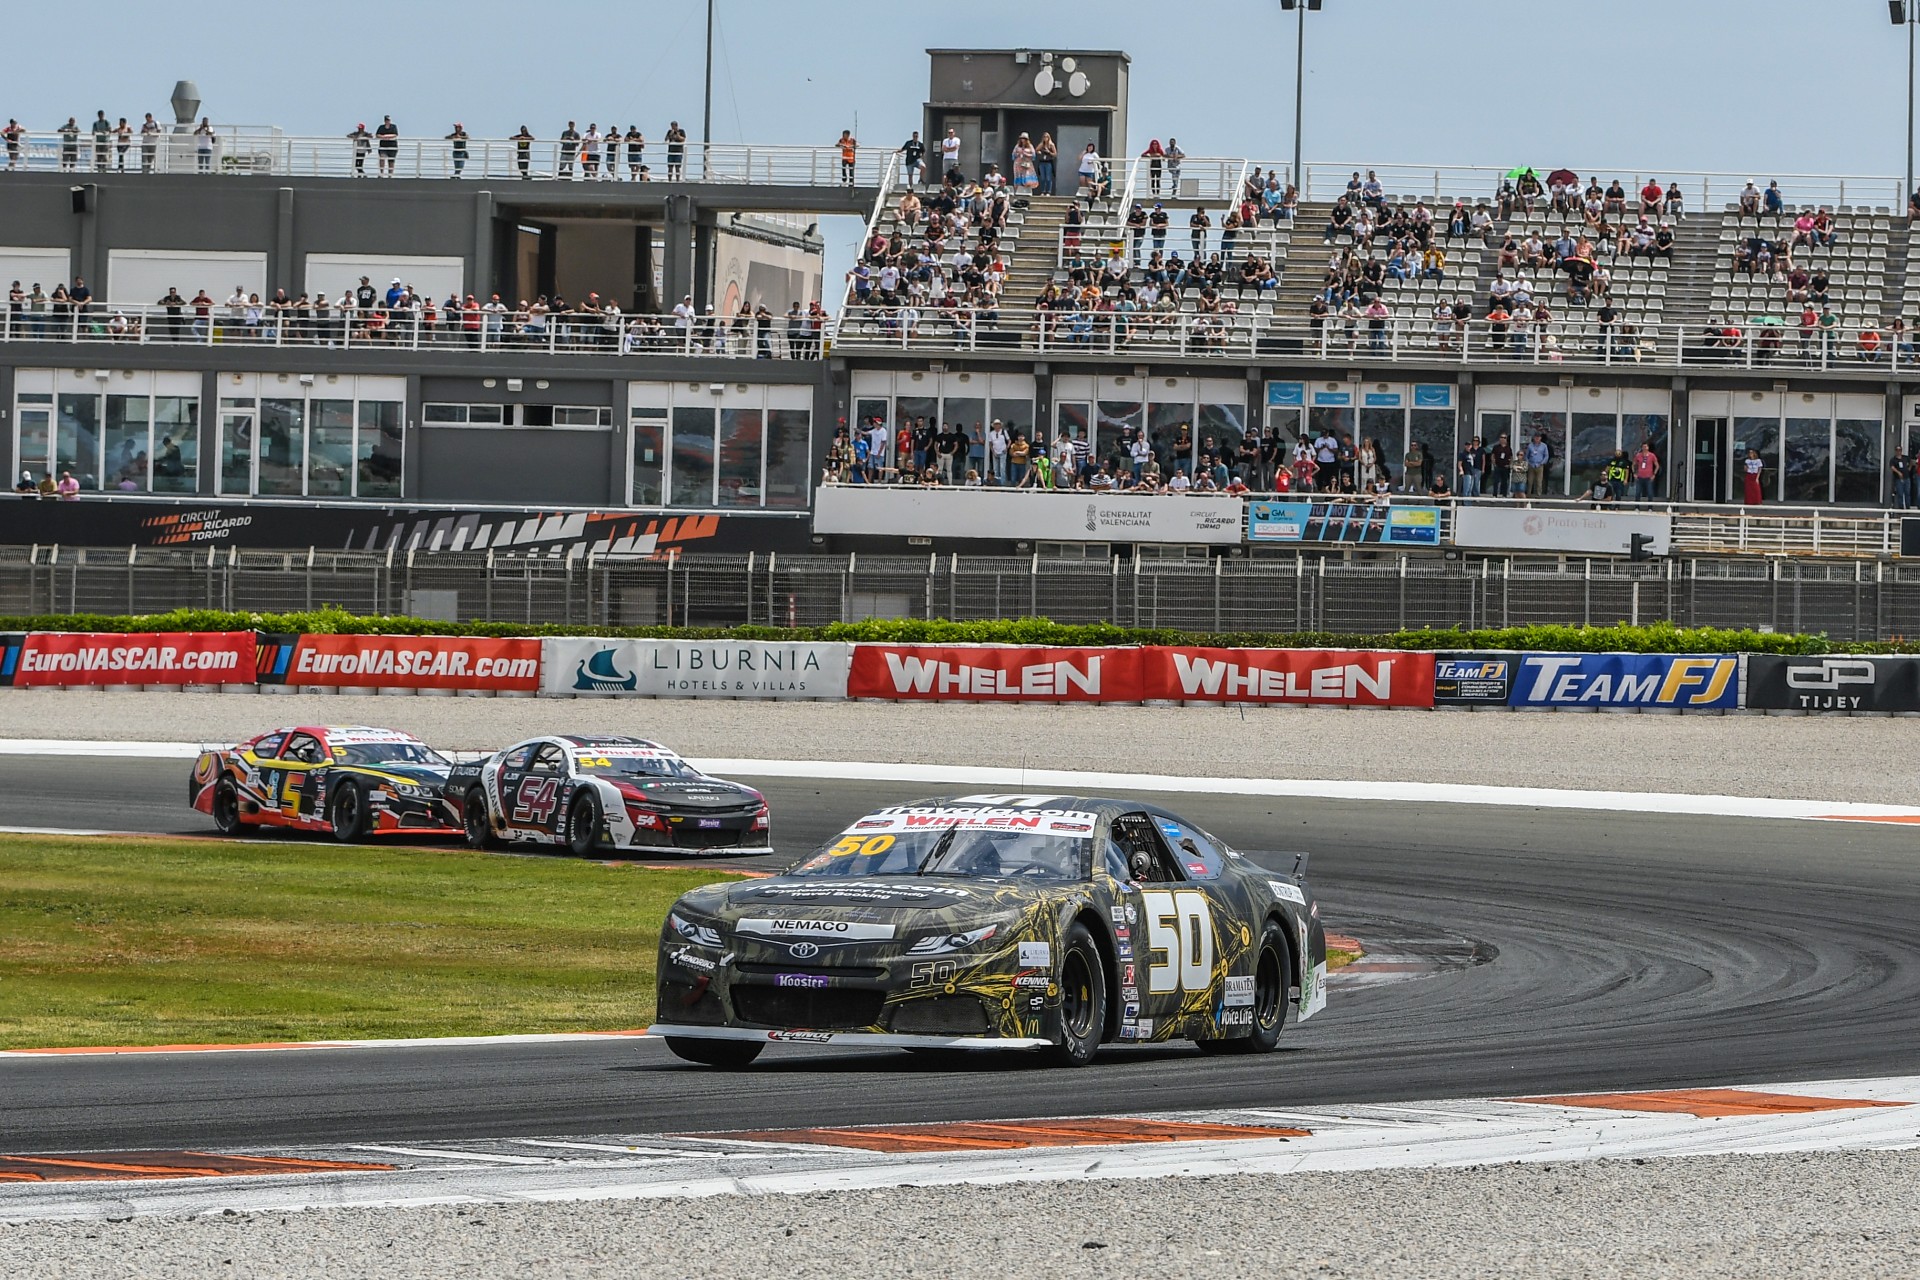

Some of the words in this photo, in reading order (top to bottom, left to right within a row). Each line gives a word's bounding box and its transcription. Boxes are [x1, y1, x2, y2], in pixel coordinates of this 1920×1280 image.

[180, 510, 221, 523] CIRCUIT
[203, 516, 252, 530] RICARDO
[1547, 516, 1578, 528] Proto
[1582, 518, 1606, 529] Tech
[192, 528, 230, 541] TORMO
[21, 646, 238, 672] EuroNASCAR.com
[296, 648, 538, 678] EuroNASCAR.com
[654, 648, 820, 671] LIBURNIA
[884, 652, 1101, 695] WHELEN
[1172, 652, 1391, 700] WHELEN
[667, 680, 728, 690] HOTELS
[736, 682, 744, 690] &
[752, 681, 806, 691] VILLAS
[1800, 696, 1862, 710] TIJEY
[330, 746, 348, 756] 5
[578, 757, 612, 768] 54
[280, 770, 307, 820] 5
[512, 776, 560, 824] 54
[636, 815, 656, 826] 54
[906, 815, 1041, 827] WHELEN
[828, 835, 896, 856] 50
[833, 891, 892, 900] Booking
[873, 889, 929, 898] Friendly
[772, 920, 848, 932] NEMACO
[1140, 890, 1214, 994] 50
[678, 954, 716, 969] HENDRIKS
[910, 960, 956, 988] 50
[779, 975, 825, 988] Hoosier
[1015, 977, 1050, 986] KENNOL
[1221, 1008, 1239, 1024] Voice
[1239, 1007, 1253, 1024] Life
